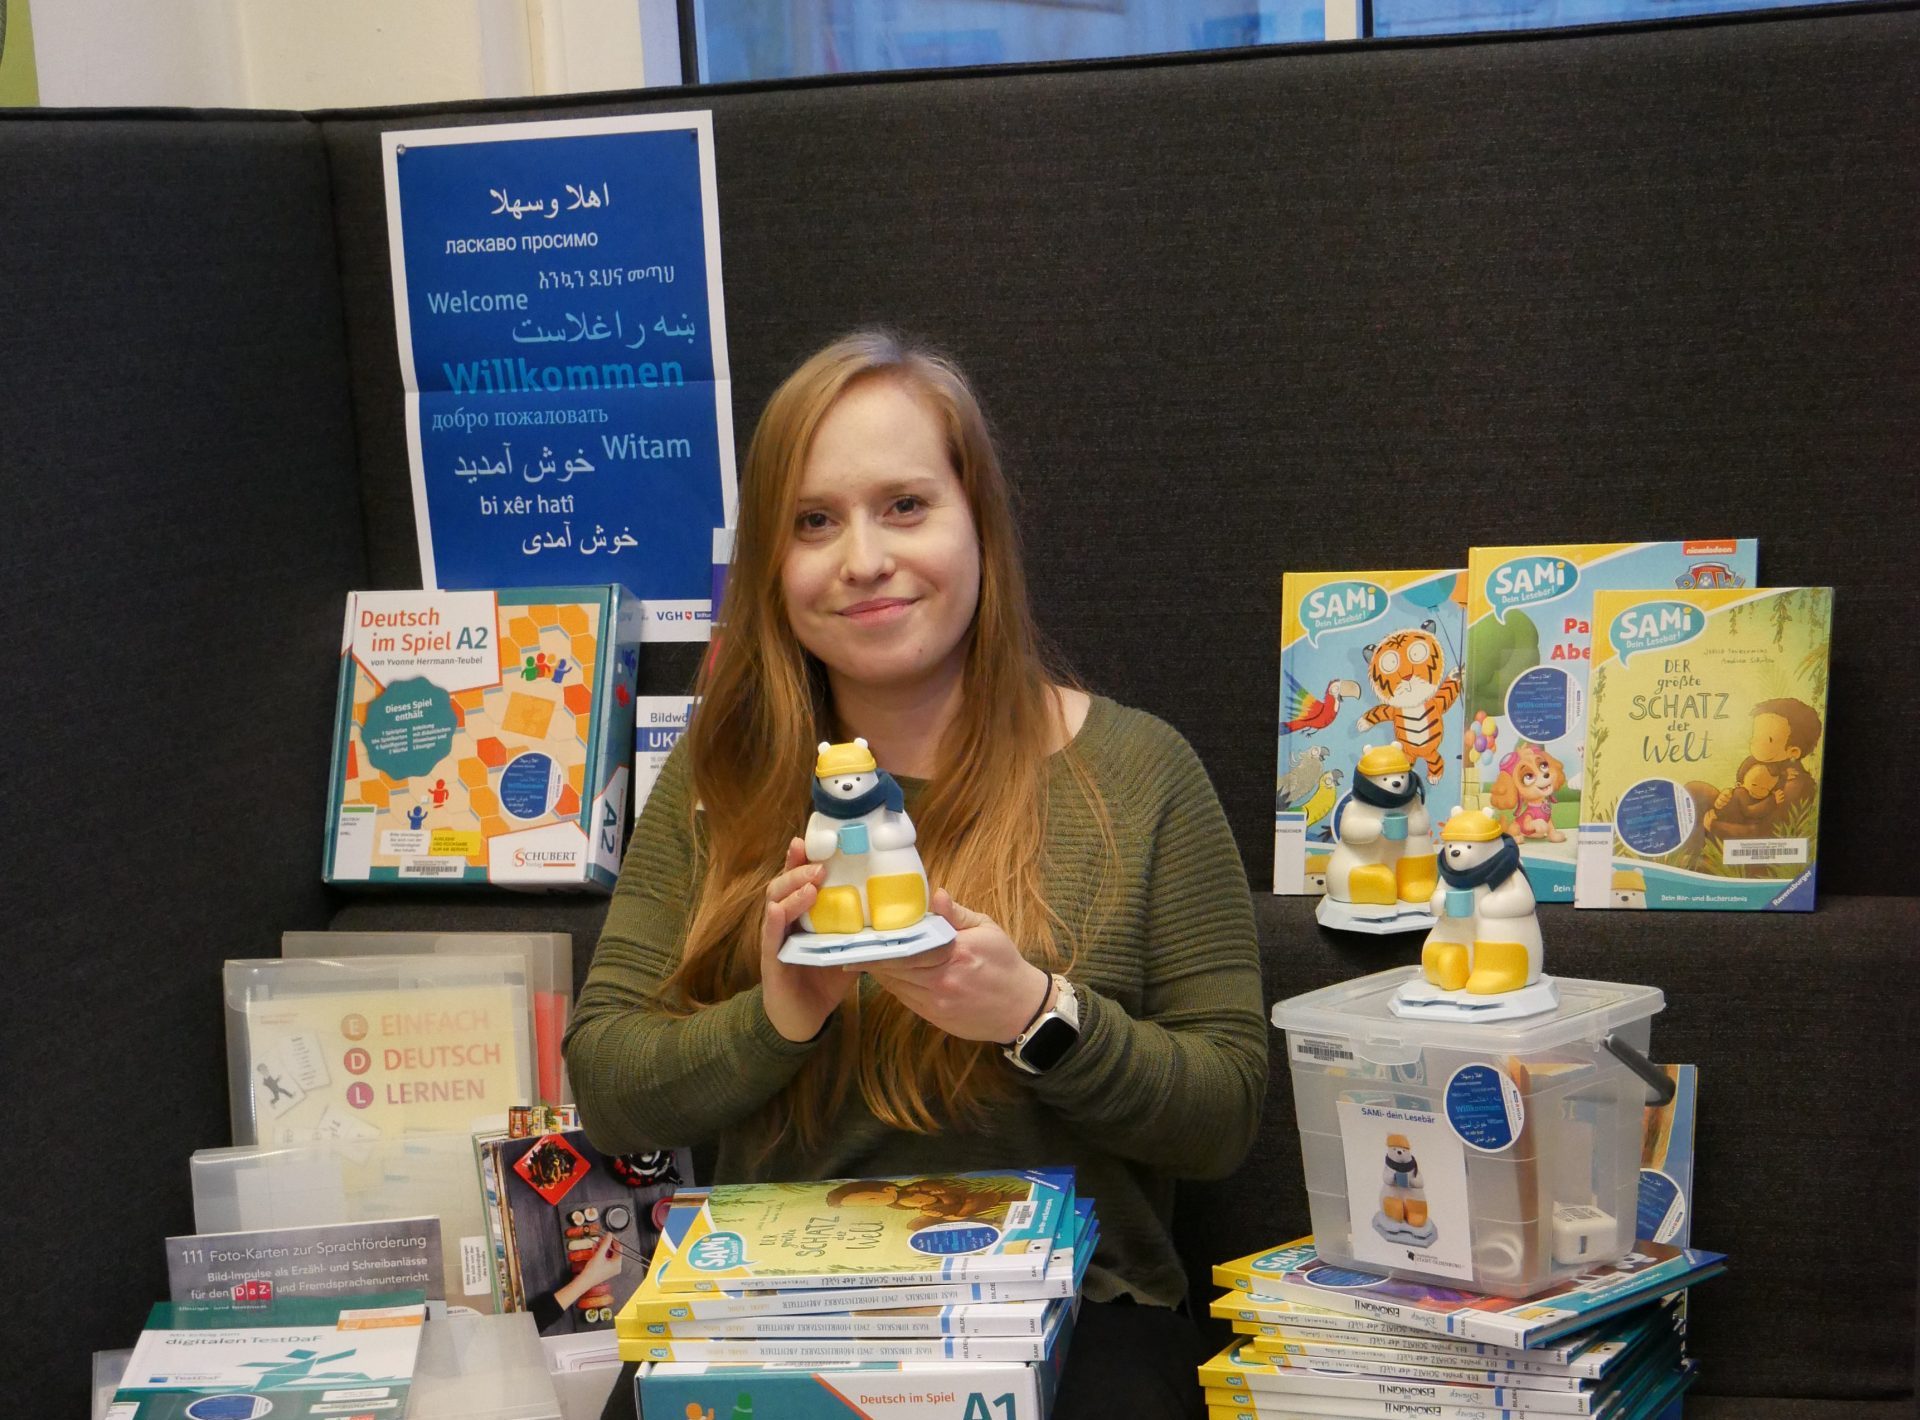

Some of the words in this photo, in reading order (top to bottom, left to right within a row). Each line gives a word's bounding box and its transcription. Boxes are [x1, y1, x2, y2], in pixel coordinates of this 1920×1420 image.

[565, 182, 610, 211] اهلا
[445, 233, 517, 254] ласкаво
[522, 231, 598, 253] просимо
[428, 290, 529, 314] Welcome
[443, 358, 685, 395] Willkommen
[432, 407, 489, 433] добро
[494, 408, 608, 426] пожаловать
[601, 434, 692, 460] Witam
[523, 446, 595, 482] خوش
[480, 496, 498, 515] bi
[503, 495, 532, 514] xêr
[537, 494, 574, 513] hatî
[580, 525, 638, 554] خوش
[361, 608, 440, 628] Deutsch
[657, 611, 683, 621] VGH
[1315, 618, 1332, 628] Dein
[372, 632, 395, 652] im
[402, 631, 451, 656] Spiel
[456, 627, 488, 650] A2
[387, 658, 415, 666] Yvonne
[1664, 659, 1690, 674] DER
[1657, 675, 1701, 694] größte
[385, 704, 411, 714] Dieses
[412, 698, 432, 710] Spiel
[395, 710, 424, 721] enthält
[1629, 693, 1730, 721] SCHATZ
[1668, 720, 1690, 732] der
[1643, 730, 1713, 764] Welt
[601, 798, 618, 855] A2
[512, 848, 577, 868] SCHUBERT
[381, 1009, 489, 1036] EINFACH
[351, 1053, 365, 1070] D
[384, 1043, 501, 1071] DEUTSCH
[356, 1087, 366, 1104] L
[387, 1078, 486, 1105] LERNEN
[1386, 1110, 1403, 1120] dein
[1405, 1113, 1435, 1124] Lesebär
[795, 1215, 840, 1258] SCHATZ
[182, 1250, 204, 1265] 111
[210, 1248, 289, 1263] Foto-Karten
[293, 1245, 313, 1256] zur
[316, 1235, 427, 1255] Sprachförderung
[207, 1268, 271, 1283] Bild-Impulse
[275, 1266, 289, 1277] als
[291, 1264, 327, 1276] Erzähl-
[330, 1261, 349, 1272] und
[352, 1256, 428, 1271] Schreibanlässe
[191, 1289, 206, 1300] für
[209, 1288, 229, 1299] den
[276, 1282, 296, 1294] und
[299, 1272, 430, 1291] Fremdsprachenunterricht
[165, 1335, 247, 1346] digitalen
[251, 1334, 323, 1344] TestDaF
[860, 1393, 906, 1405] Deutsch
[909, 1392, 924, 1404] im
[927, 1391, 956, 1405] Spiel
[962, 1392, 1017, 1420] A1
